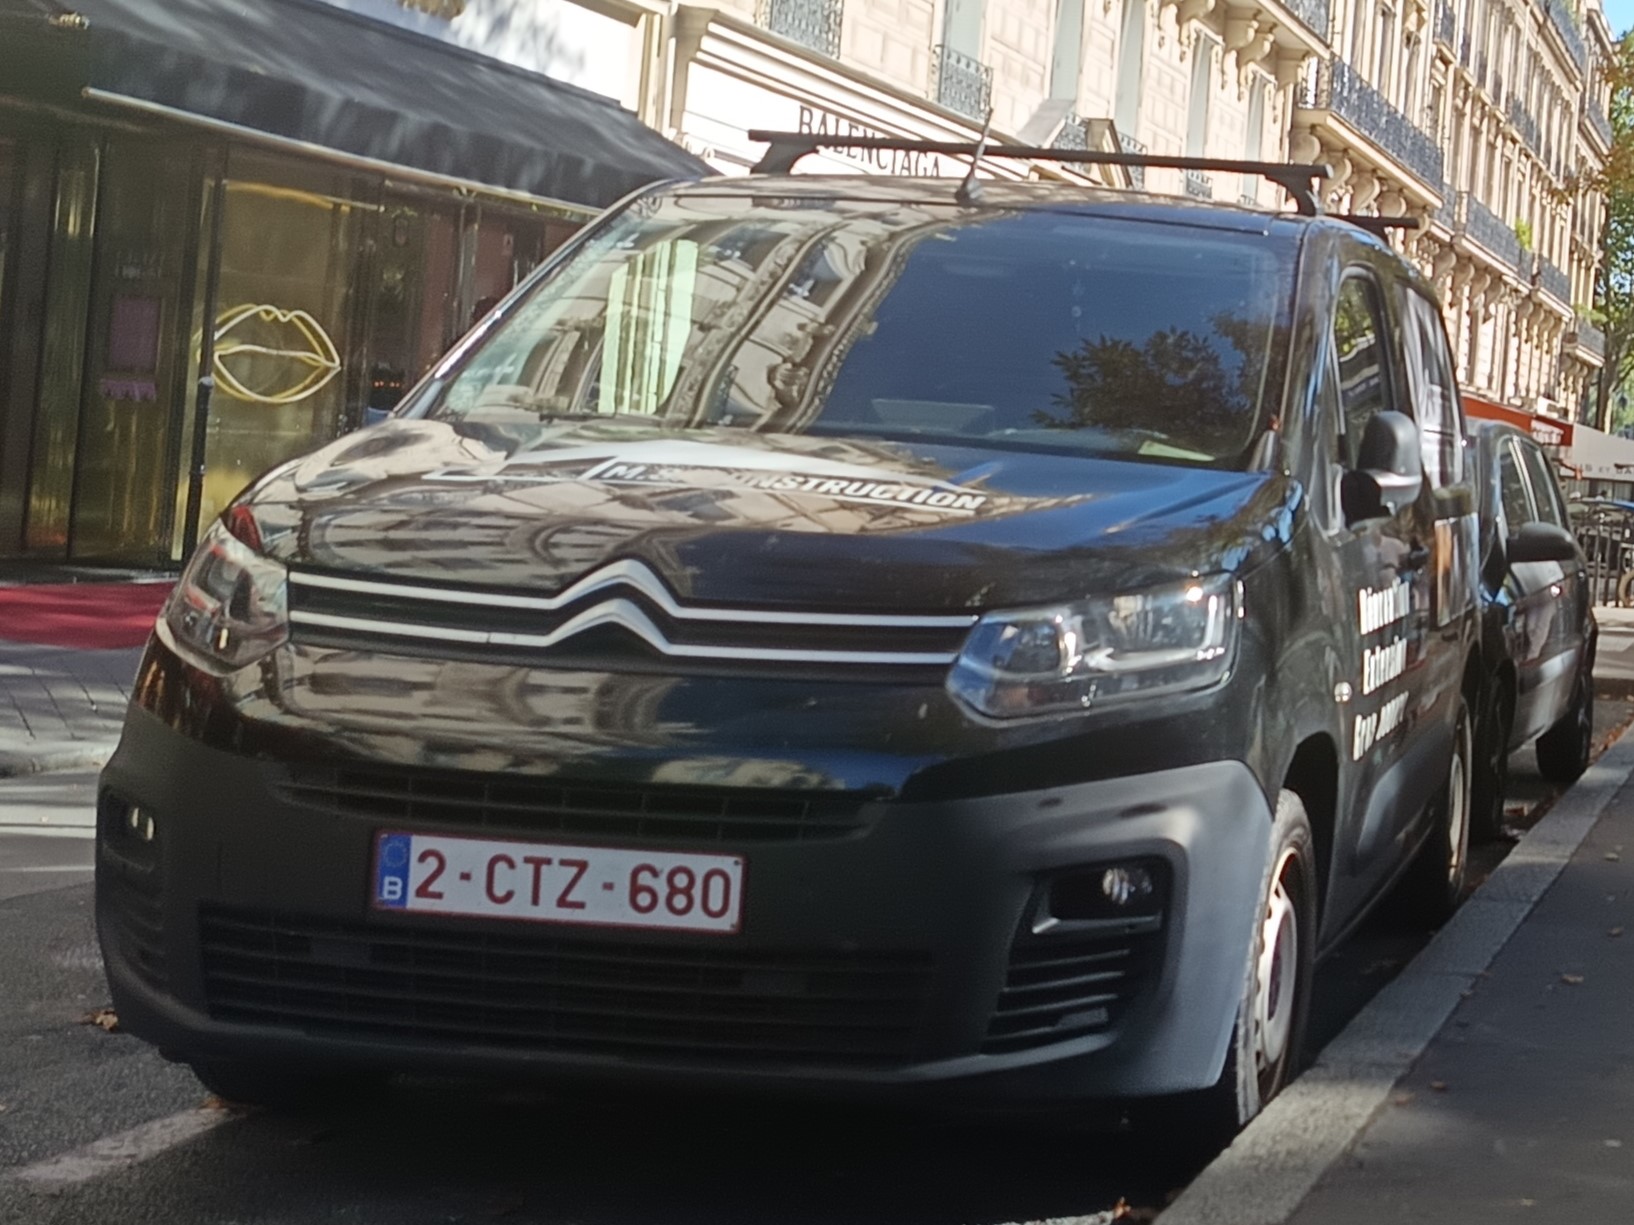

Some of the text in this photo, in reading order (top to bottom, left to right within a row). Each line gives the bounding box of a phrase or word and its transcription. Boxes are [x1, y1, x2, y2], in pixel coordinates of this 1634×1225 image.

[799, 105, 941, 177] BALENCIAGA
[383, 876, 403, 900] B
[415, 849, 731, 918] 2-CTZ-680
